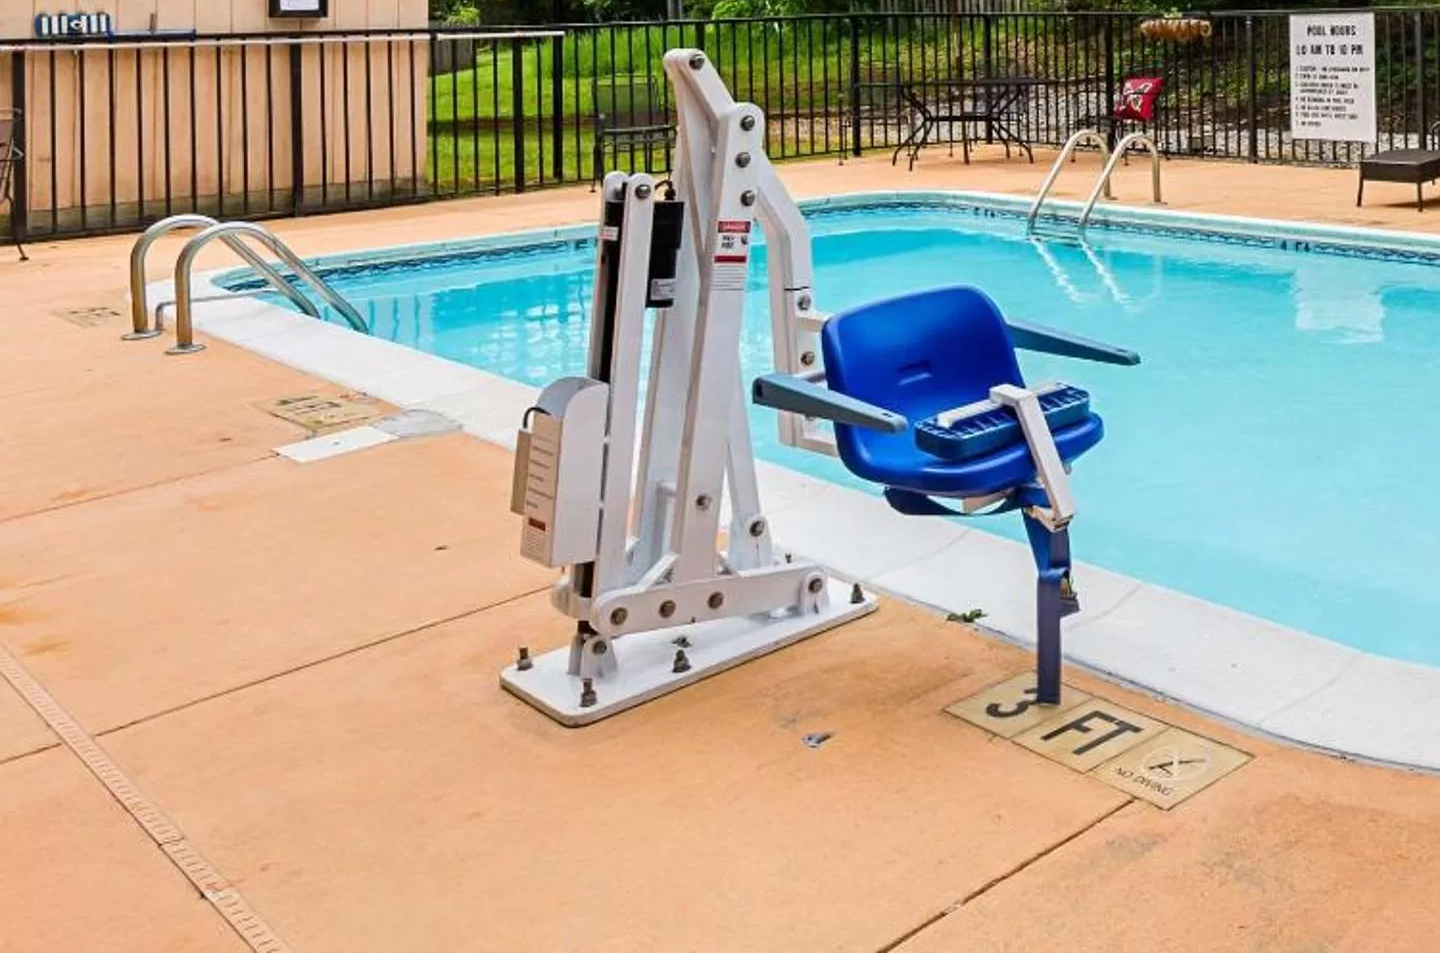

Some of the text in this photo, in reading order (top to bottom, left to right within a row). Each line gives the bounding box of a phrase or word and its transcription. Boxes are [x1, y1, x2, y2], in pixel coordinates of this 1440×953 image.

[1307, 25, 1356, 36] POOL HOURS
[1310, 44, 1322, 55] AM
[1325, 44, 1335, 56] TO
[1351, 44, 1364, 55] PM
[986, 688, 1144, 756] 3 FT
[1116, 766, 1174, 797] NO DIVING
